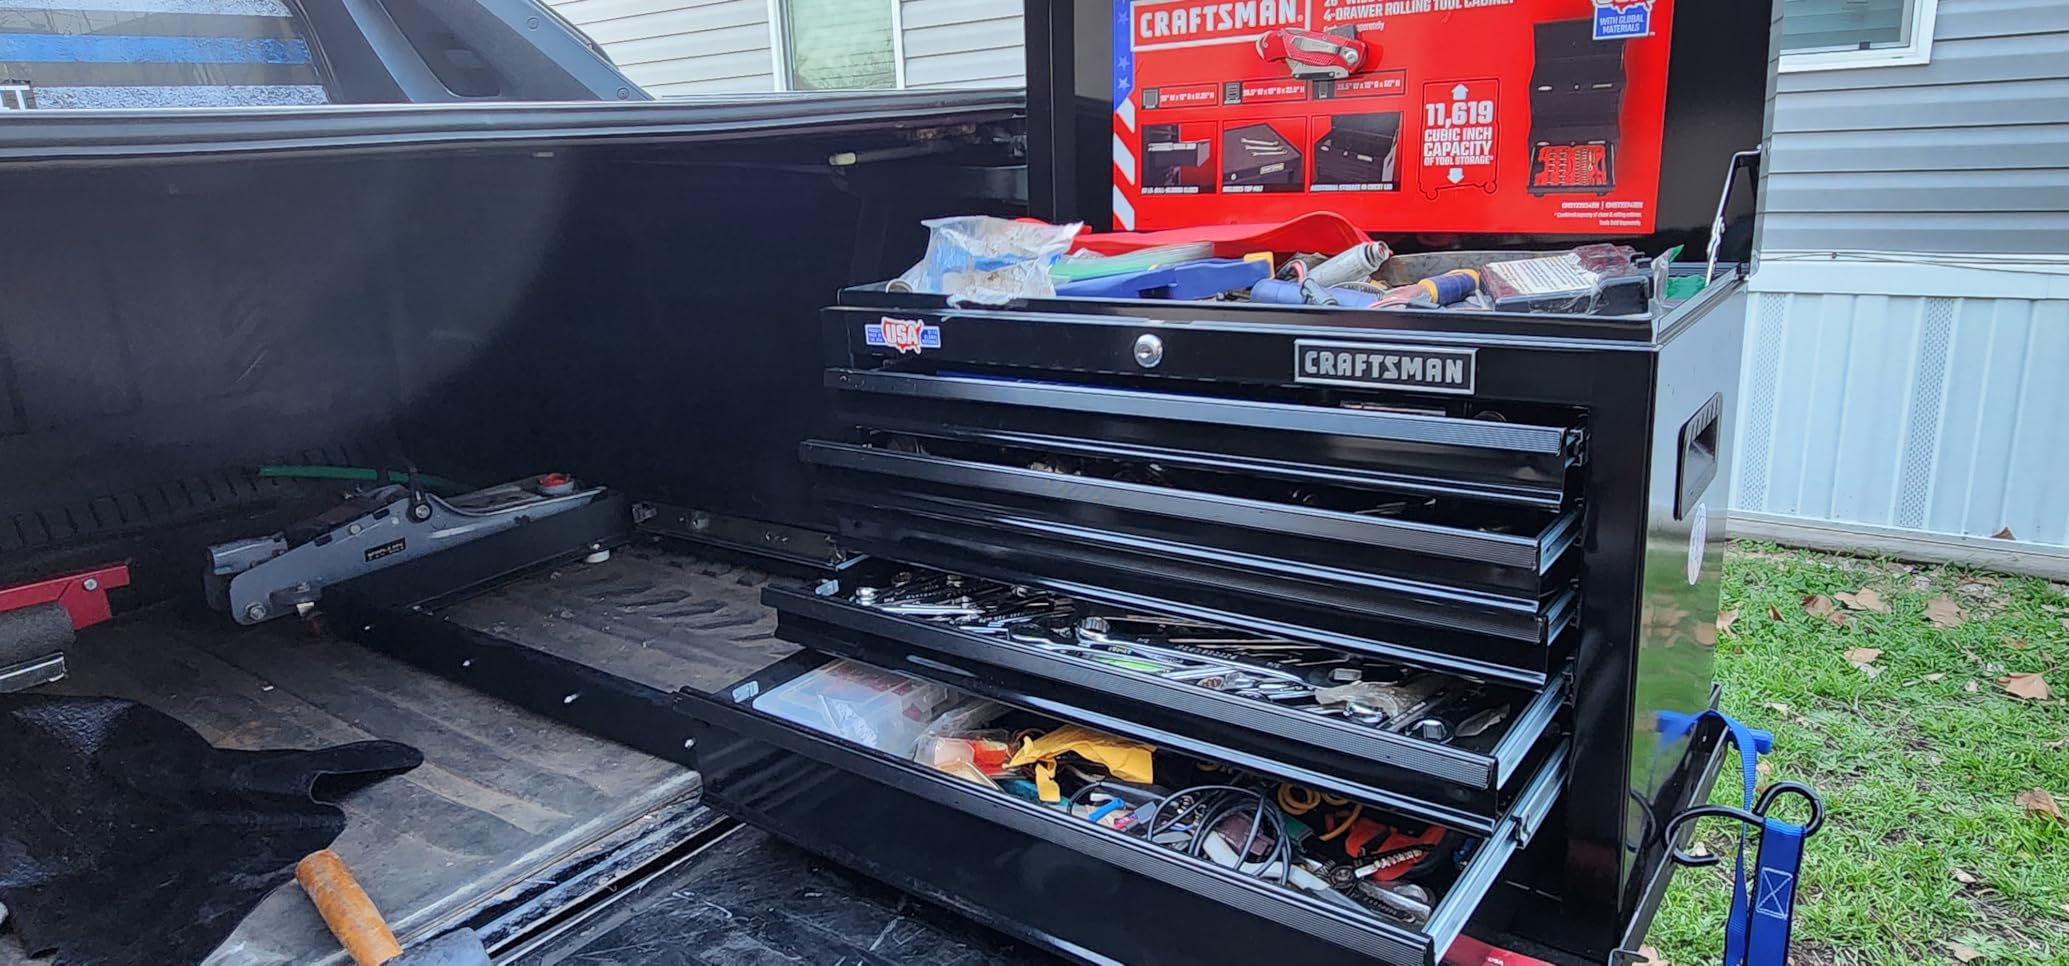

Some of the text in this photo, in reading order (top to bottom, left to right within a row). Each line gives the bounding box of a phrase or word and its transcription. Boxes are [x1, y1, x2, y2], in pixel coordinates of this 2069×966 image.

[1140, 0, 1297, 38] CRAFTSMAN
[1323, 4, 1383, 21] 4-DRAWER
[1385, 0, 1431, 16] ROLLING
[1433, 0, 1462, 11] TOOL
[1600, 14, 1644, 26] WITH GLOBAL
[1602, 23, 1640, 34] MATERIALS
[1425, 100, 1494, 129] 11,619
[1424, 126, 1493, 142] CUBIC INCH
[1423, 140, 1493, 157] CAPACITY
[1423, 156, 1434, 166] OF
[1435, 156, 1454, 166] TOOL
[885, 323, 918, 345] USA
[1304, 350, 1463, 384] CRAFTSMAN
